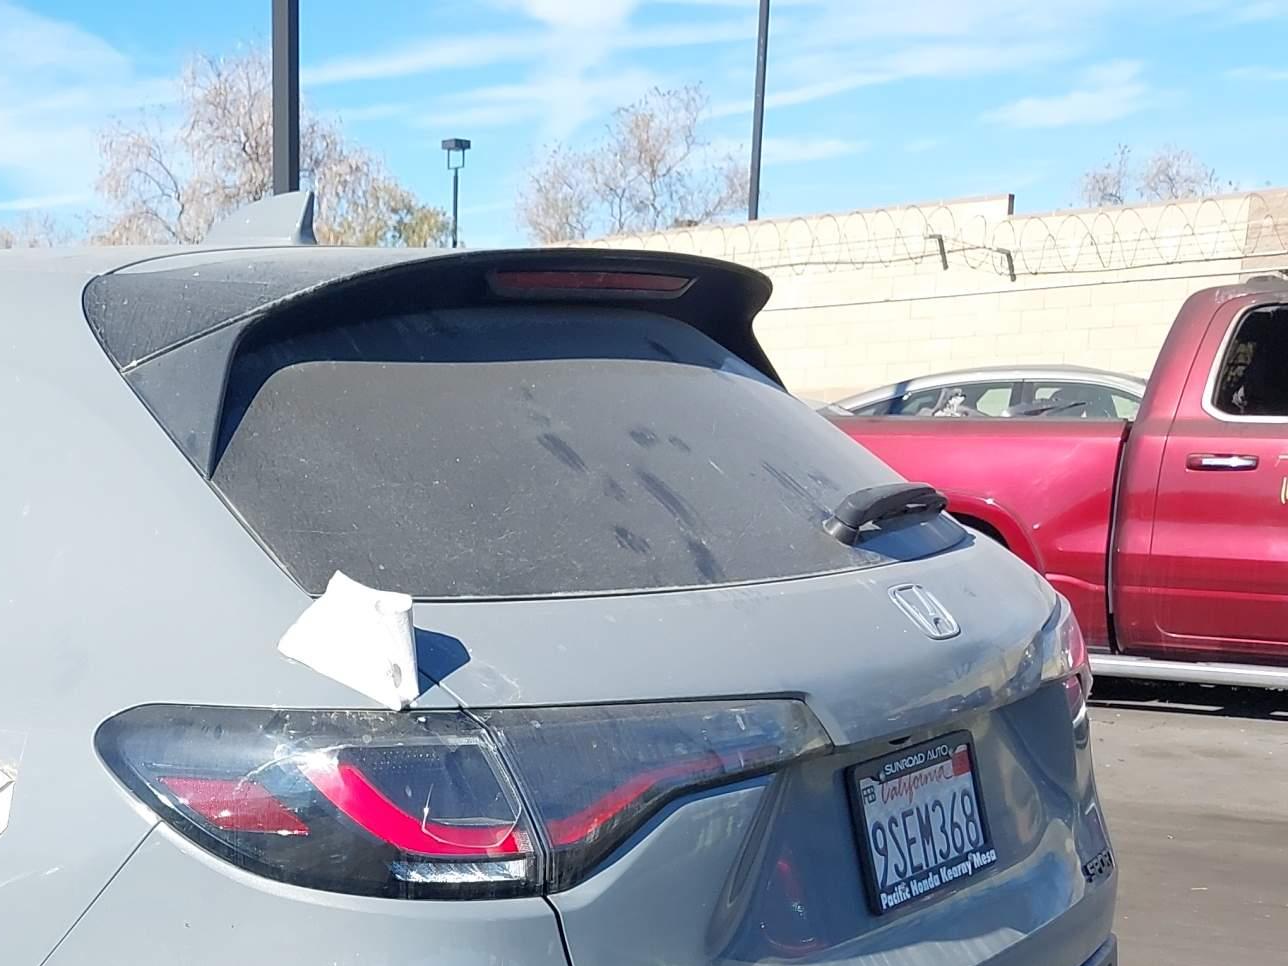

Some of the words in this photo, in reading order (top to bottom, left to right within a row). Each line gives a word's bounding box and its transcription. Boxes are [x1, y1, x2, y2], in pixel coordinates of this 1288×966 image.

[884, 753, 925, 776] SUNROAD
[927, 744, 949, 761] AUTO
[881, 766, 952, 804] California
[872, 788, 980, 889] 9SEM368
[880, 883, 911, 910] Pacific
[910, 872, 941, 897] Honda
[939, 859, 972, 883] Kearny
[972, 849, 997, 869] Mesa
